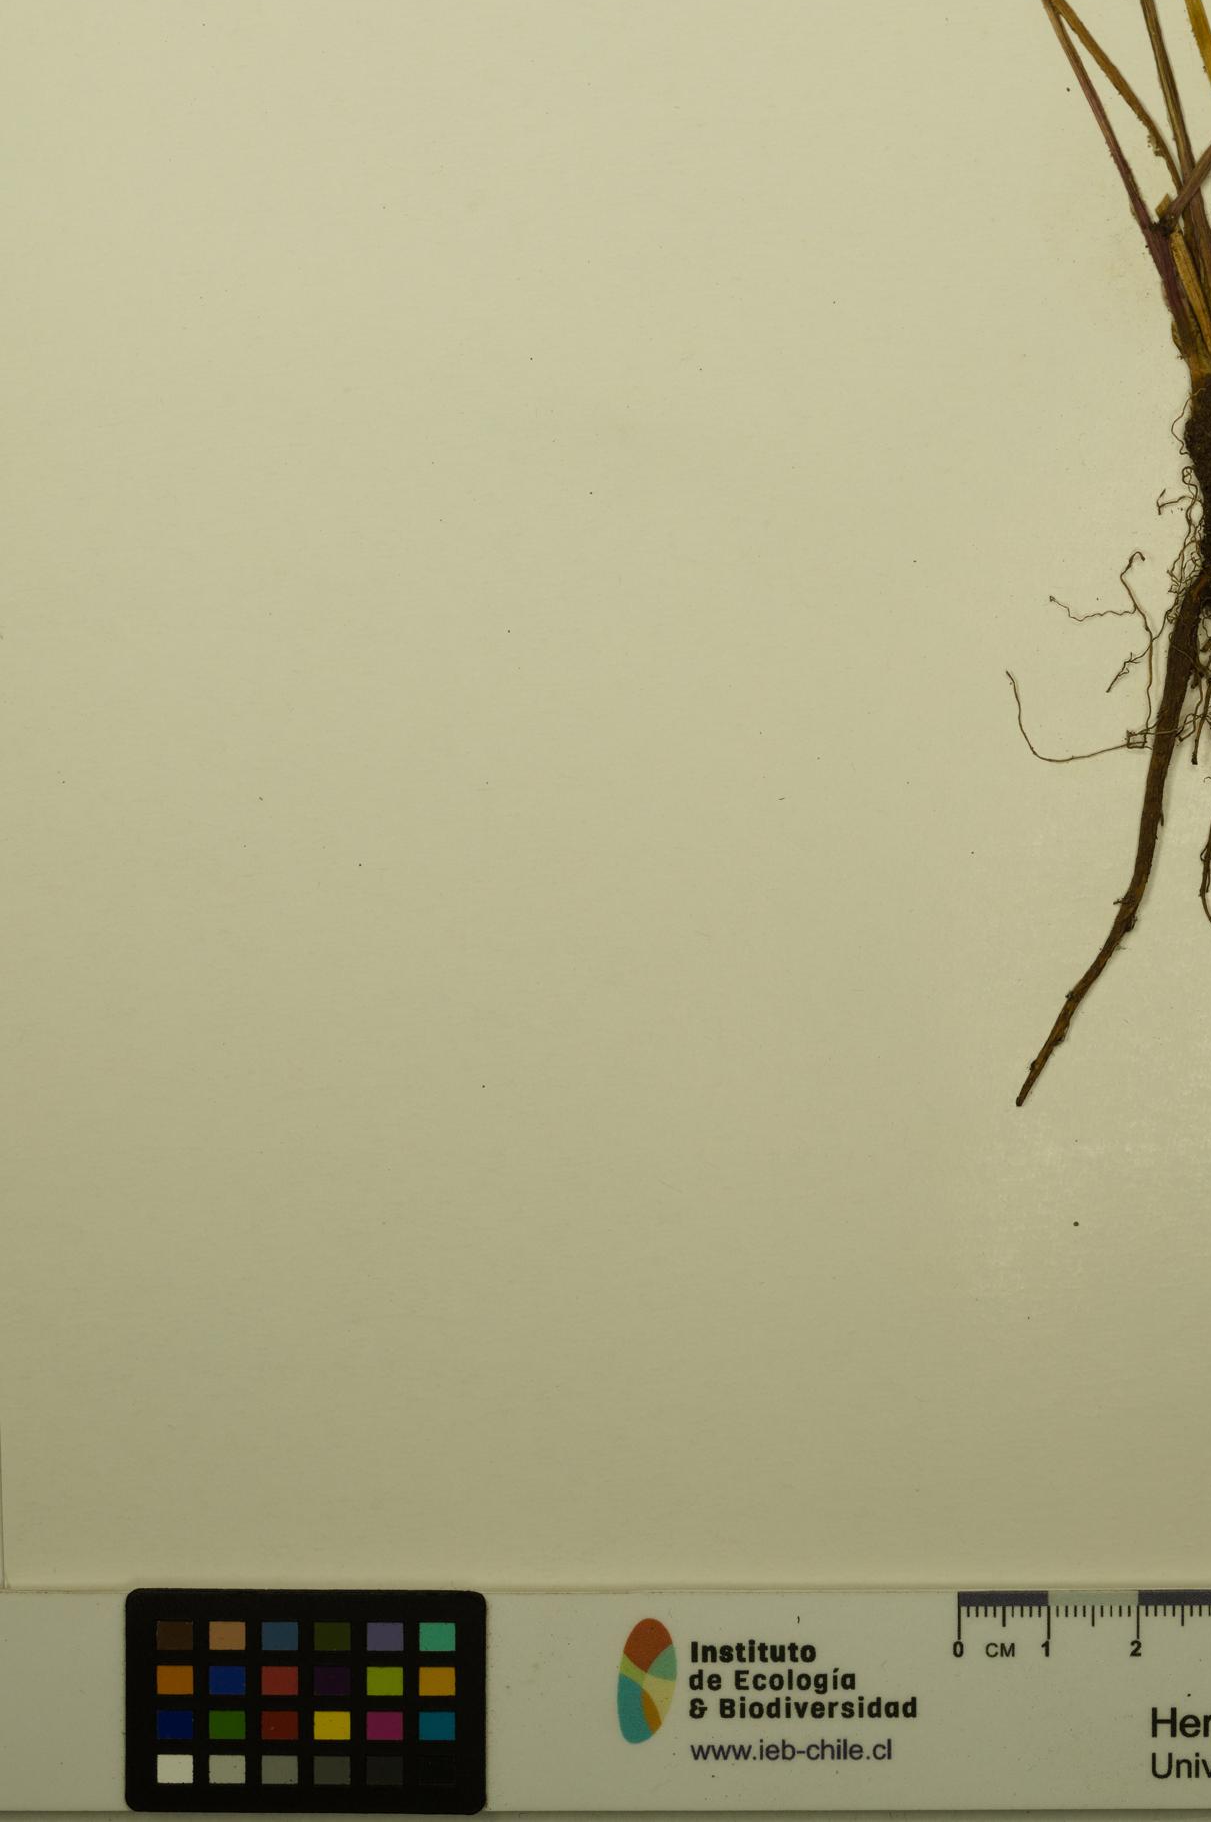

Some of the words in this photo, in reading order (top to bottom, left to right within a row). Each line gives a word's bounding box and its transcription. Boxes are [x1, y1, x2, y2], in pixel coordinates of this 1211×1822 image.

[690, 1640, 817, 1664] Instituto
[951, 1641, 964, 1658] 0
[985, 1642, 1016, 1658] CM
[1040, 1640, 1051, 1657] 1
[1129, 1640, 1142, 1657] 2
[688, 1668, 722, 1692] de
[734, 1666, 856, 1698] Ecología
[688, 1697, 708, 1720] &
[719, 1695, 918, 1720] Biodiversidad
[690, 1738, 893, 1762] www.ieb-chile.cl
